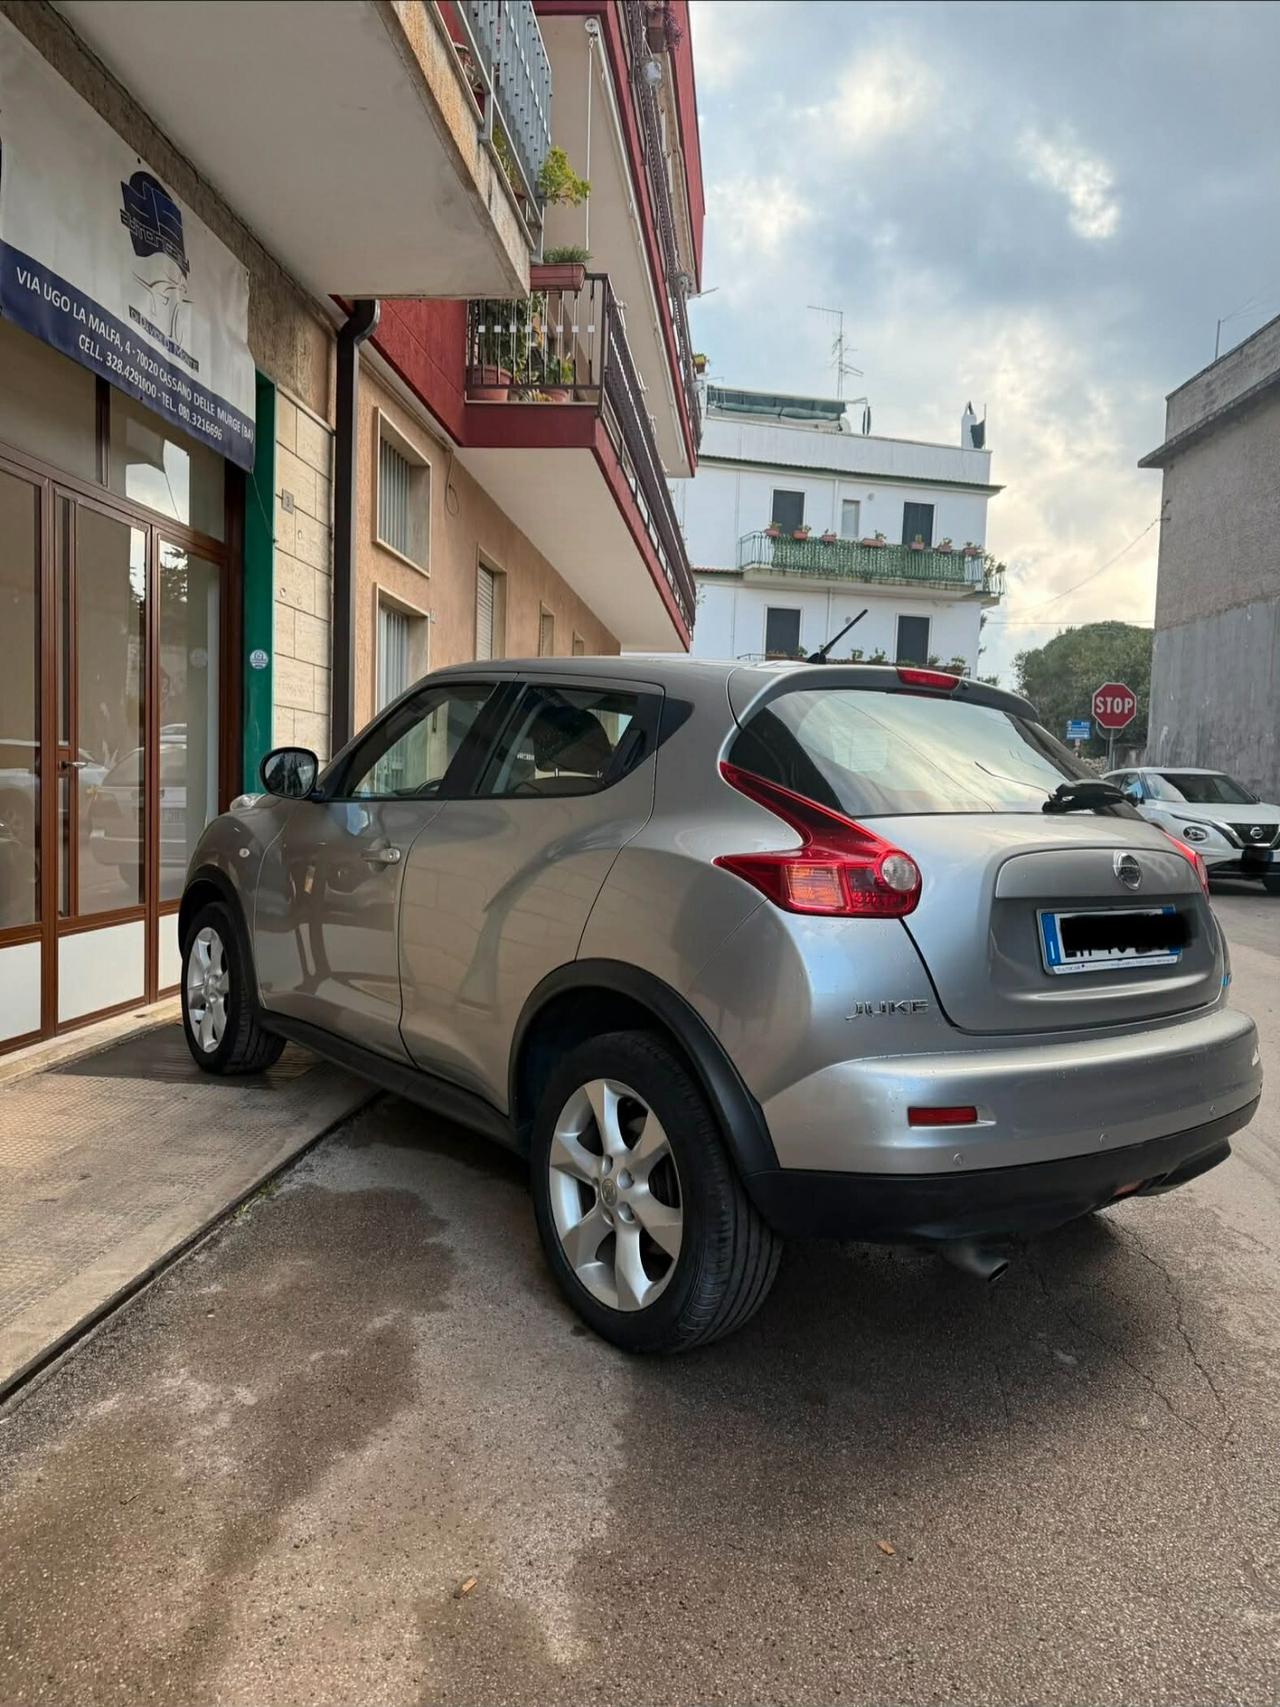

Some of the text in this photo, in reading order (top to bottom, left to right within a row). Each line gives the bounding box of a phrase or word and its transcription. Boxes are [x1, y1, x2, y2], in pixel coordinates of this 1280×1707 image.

[16, 266, 41, 294] VIA
[43, 283, 70, 312] UGO
[73, 302, 86, 324] LA
[88, 313, 124, 352] MALFA,
[124, 341, 131, 355] 4
[136, 349, 159, 377] 70020
[159, 368, 192, 401] CASSANO
[193, 393, 216, 417] DELLE
[217, 407, 241, 433] MURGE
[78, 334, 103, 361] CELL.
[161, 392, 177, 412] TEL.
[1095, 696, 1134, 714] STOP
[845, 999, 929, 1020] JUKE
